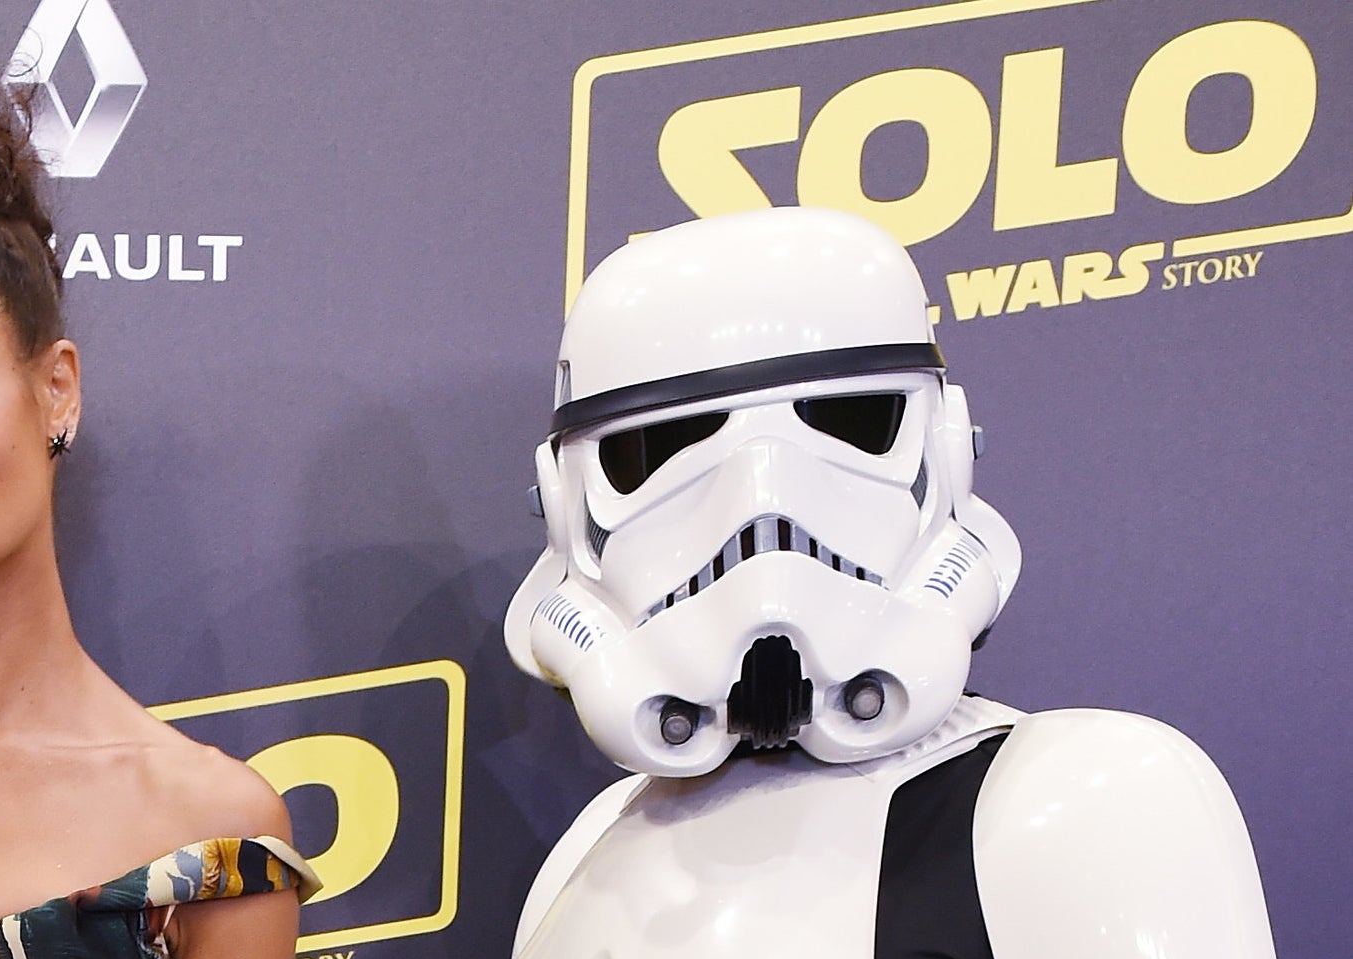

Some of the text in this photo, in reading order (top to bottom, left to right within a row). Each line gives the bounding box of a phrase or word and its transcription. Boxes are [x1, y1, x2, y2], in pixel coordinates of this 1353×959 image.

[48, 233, 243, 281] AULT
[946, 242, 1263, 321] WARS STORY
